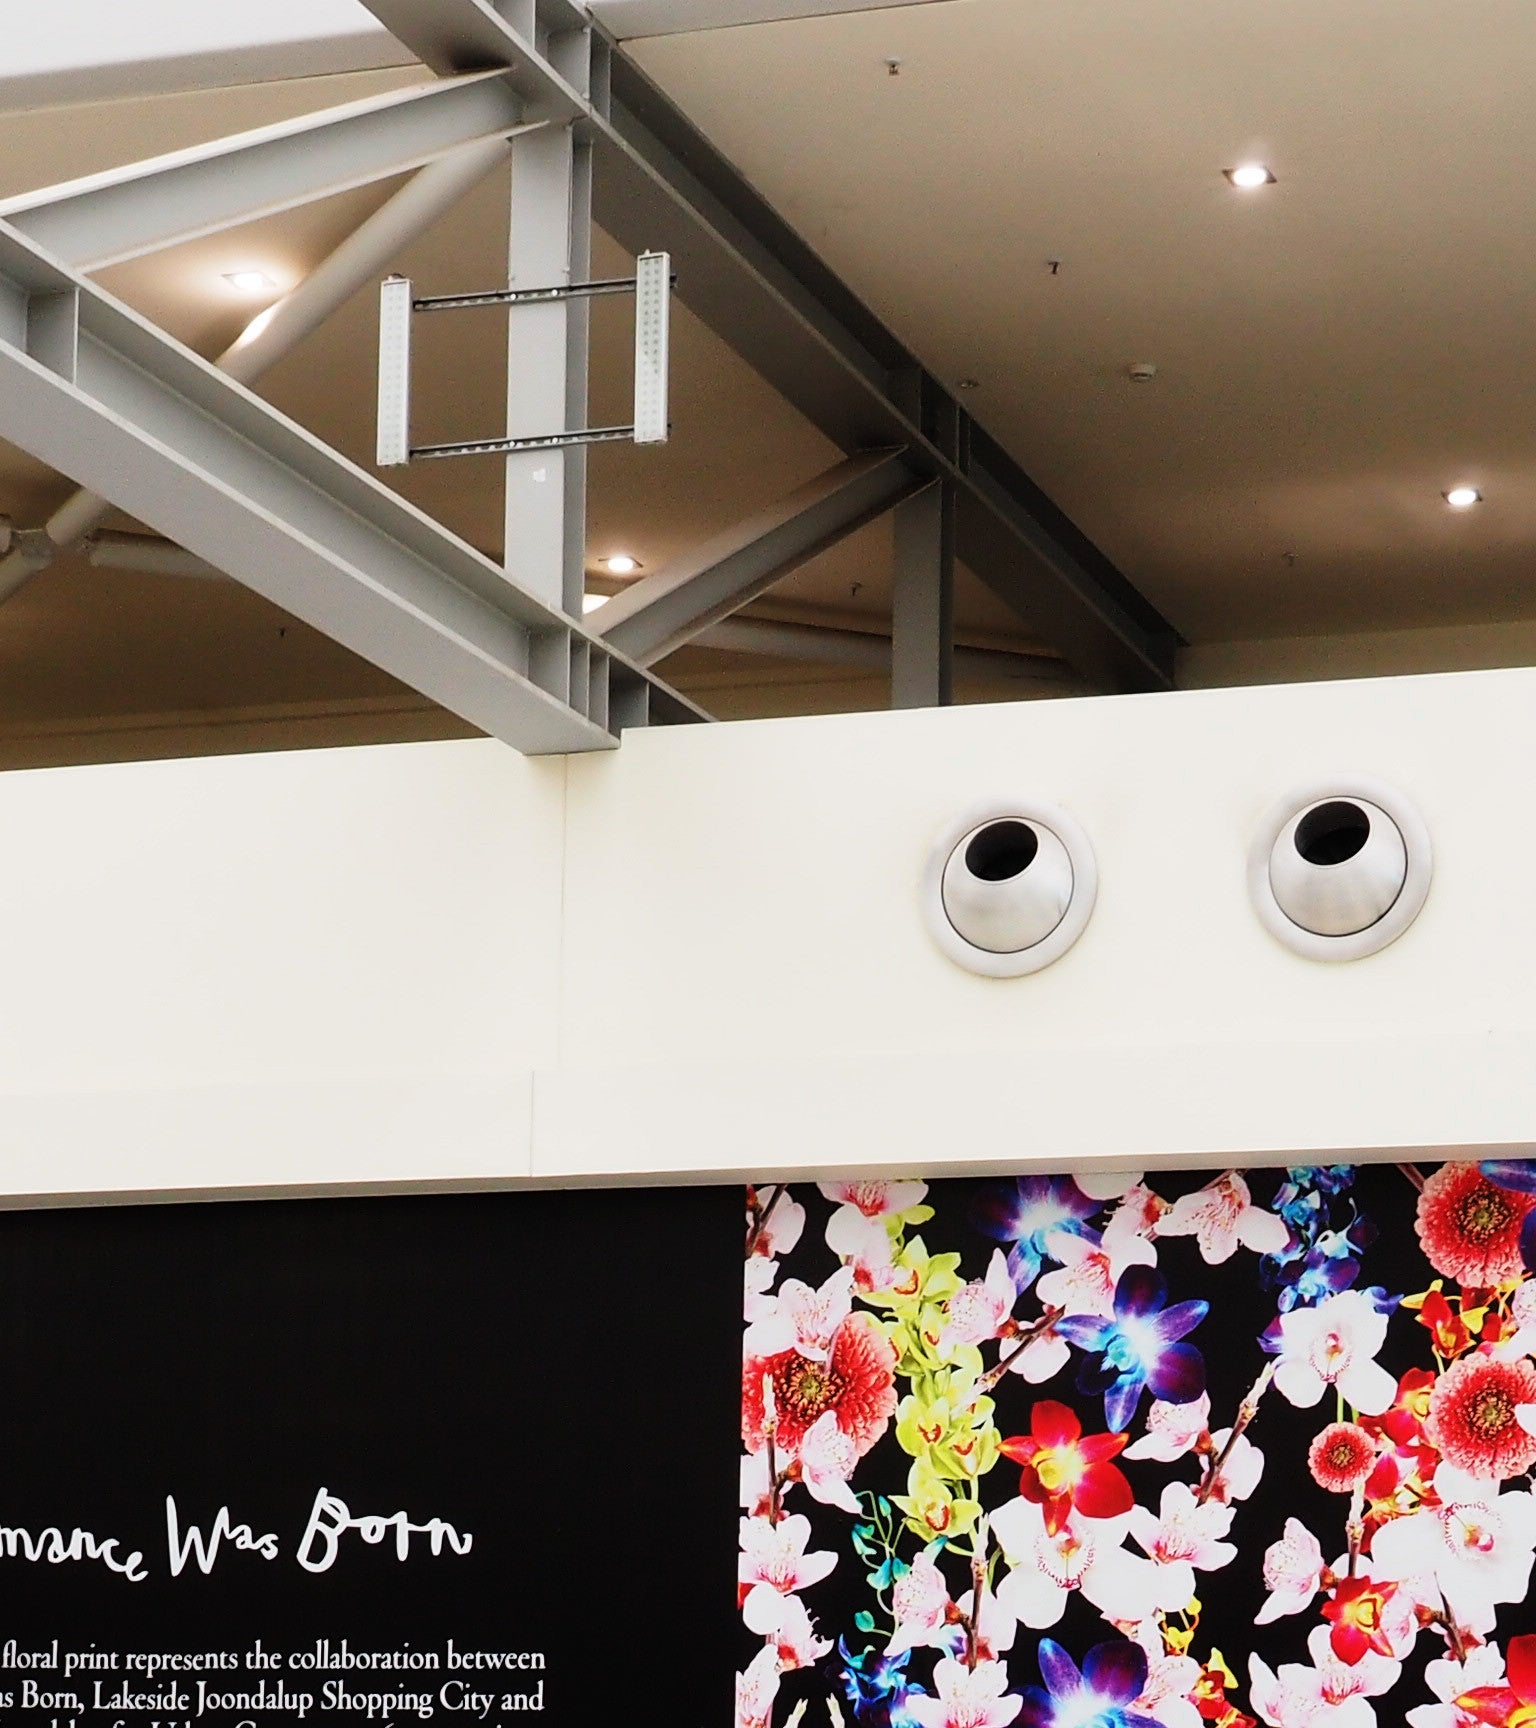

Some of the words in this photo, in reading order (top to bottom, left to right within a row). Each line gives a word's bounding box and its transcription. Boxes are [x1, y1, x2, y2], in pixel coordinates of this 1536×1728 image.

[166, 1495, 278, 1577] Was
[296, 1487, 472, 1572] Born
[2, 1640, 58, 1668] floral
[64, 1644, 119, 1677] print
[126, 1652, 238, 1678] represents
[246, 1640, 282, 1669] the
[289, 1639, 439, 1669] collaboration
[447, 1639, 546, 1669] between
[21, 1680, 84, 1714] Born,
[93, 1680, 189, 1710] Lakeside
[196, 1679, 313, 1718] Joondalup
[321, 1680, 433, 1719] Shopping
[440, 1681, 495, 1719] City
[501, 1680, 544, 1710] and
